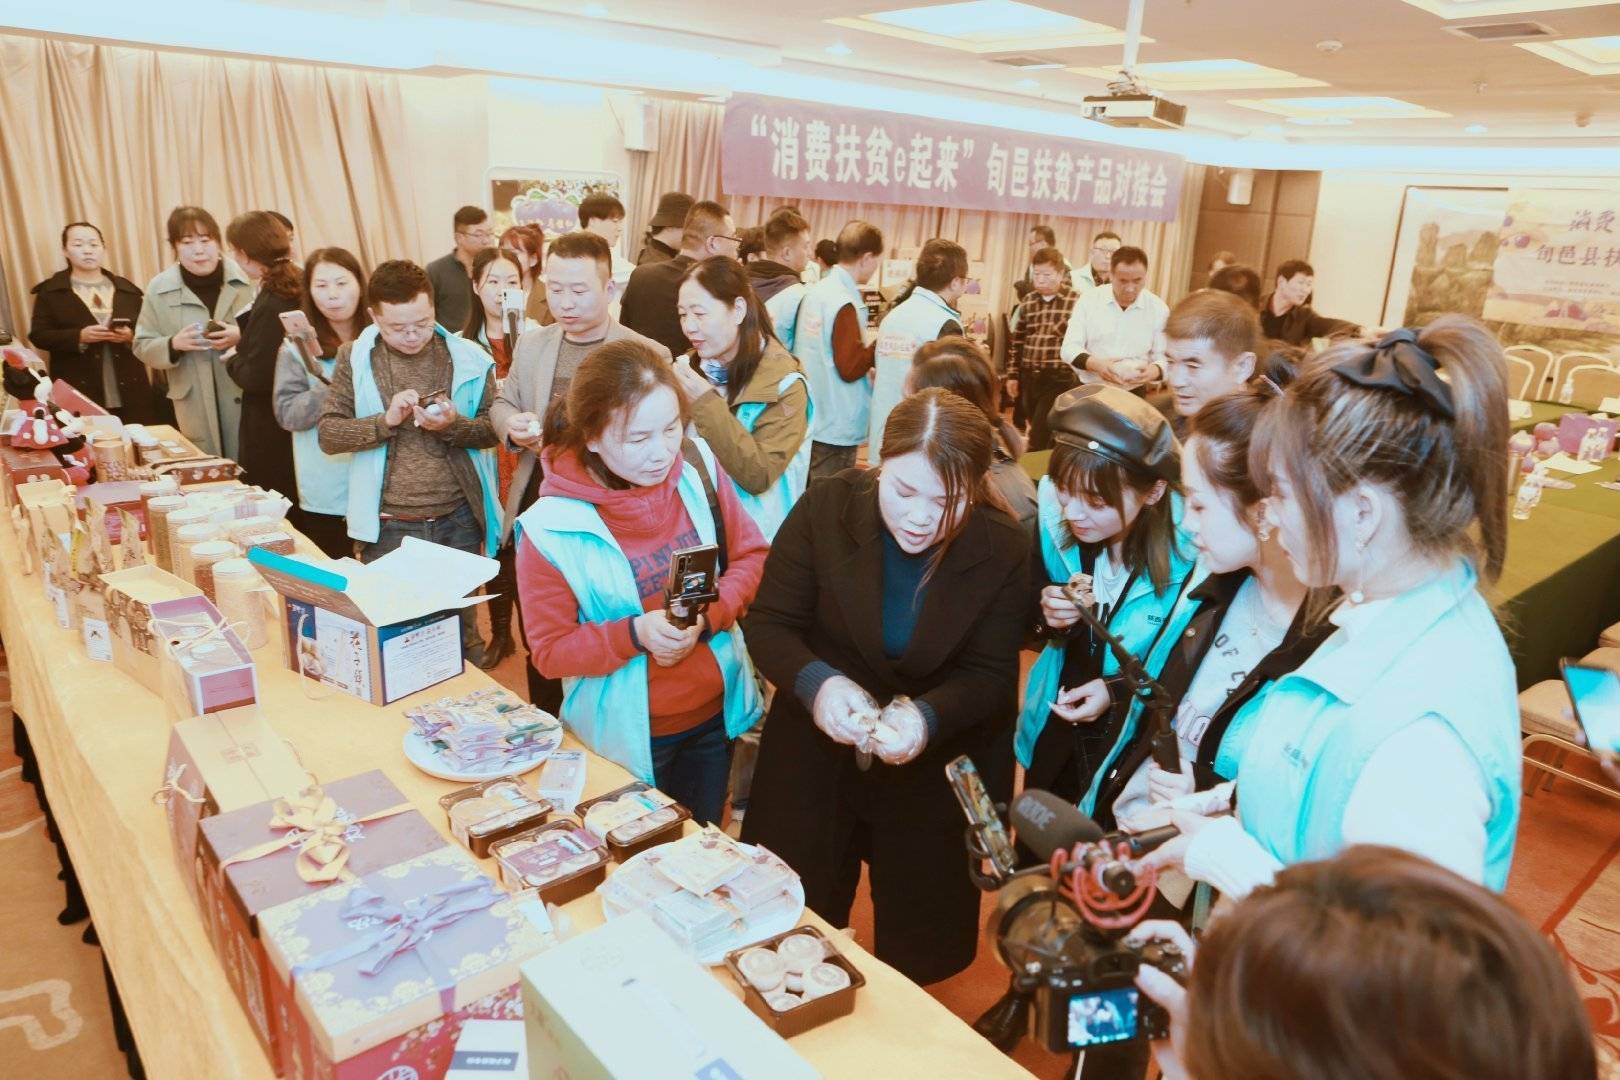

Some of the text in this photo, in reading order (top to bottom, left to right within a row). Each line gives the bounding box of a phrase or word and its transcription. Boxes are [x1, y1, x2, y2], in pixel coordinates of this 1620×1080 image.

[986, 142, 1169, 208] 旬邑扶贫产品对接会
